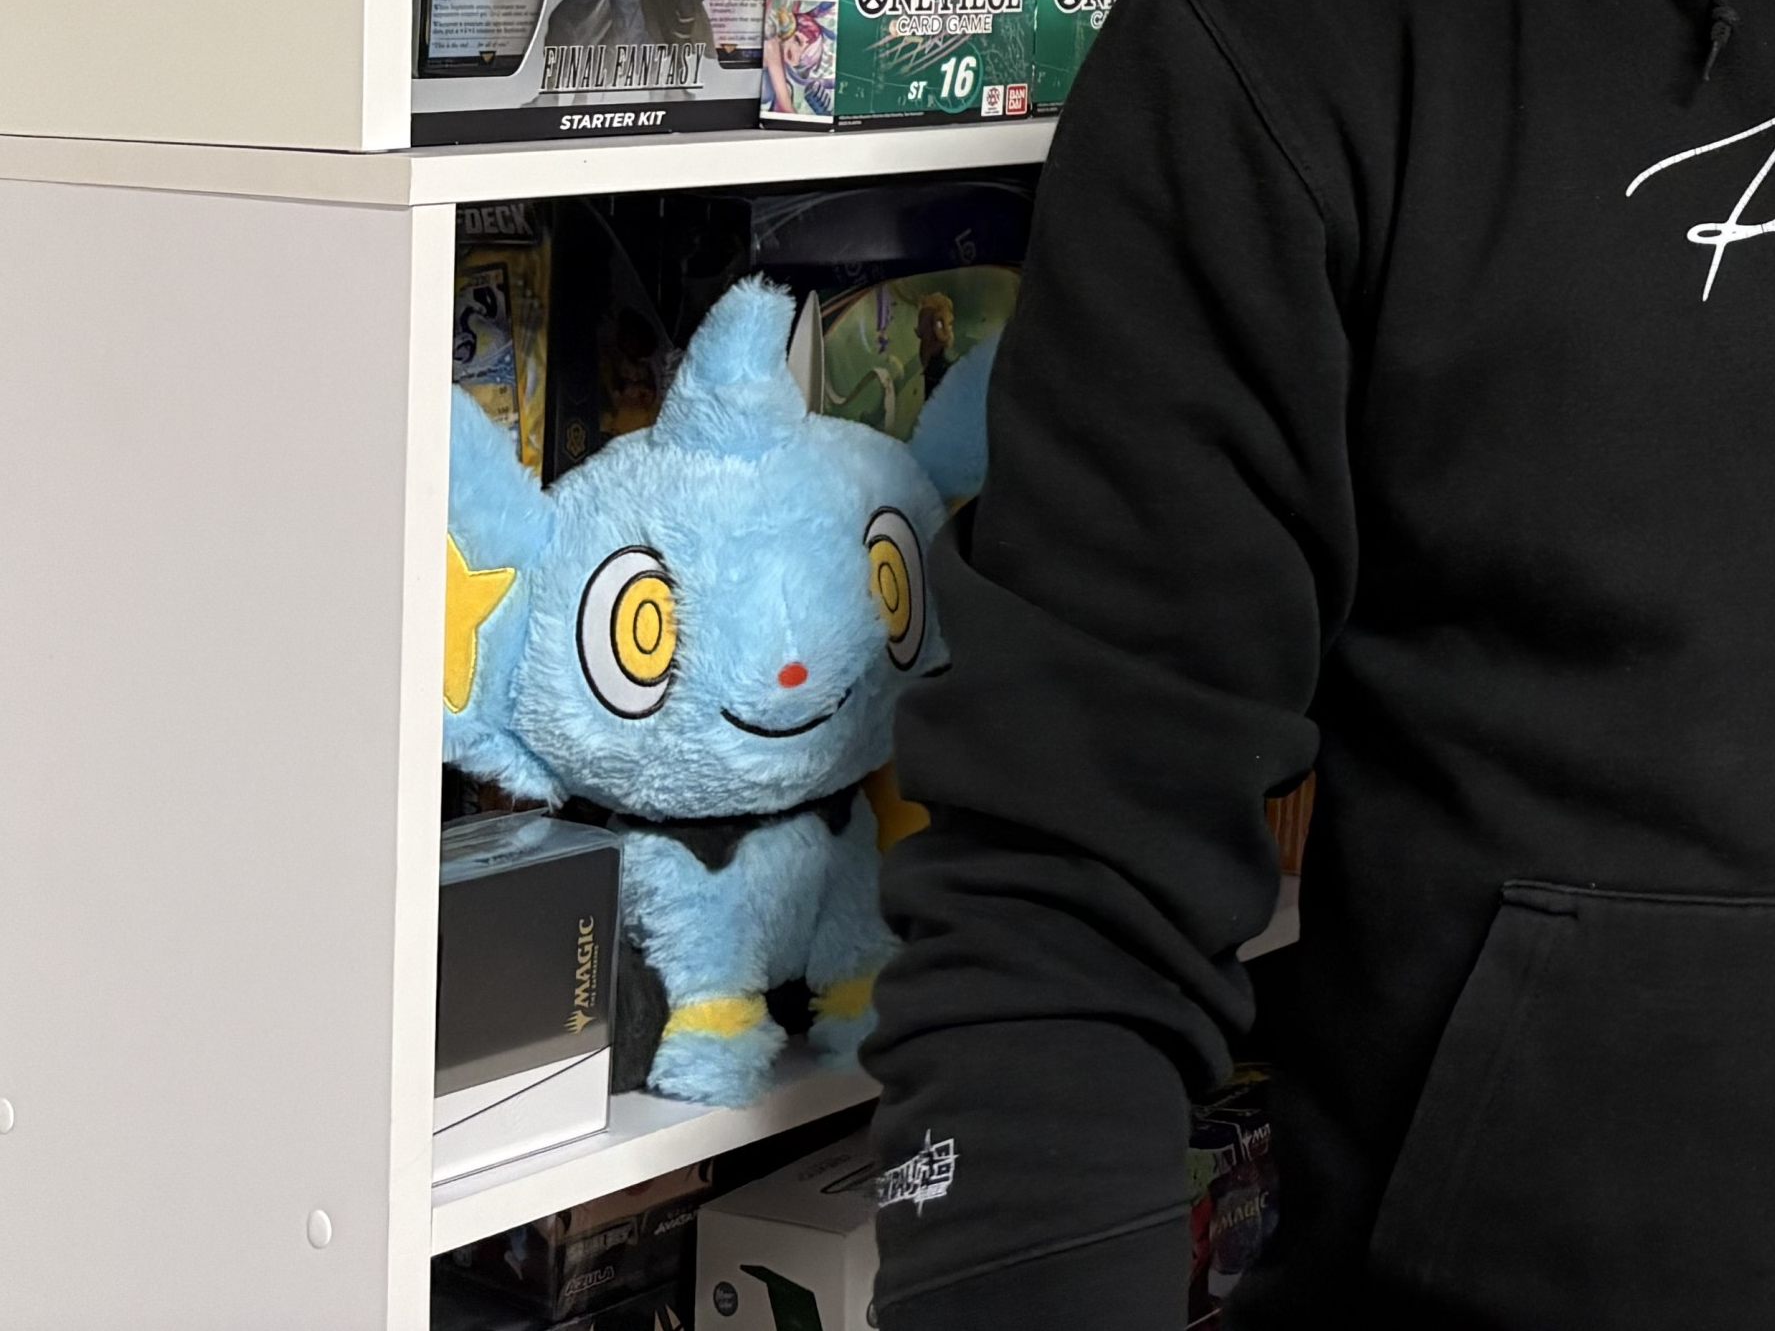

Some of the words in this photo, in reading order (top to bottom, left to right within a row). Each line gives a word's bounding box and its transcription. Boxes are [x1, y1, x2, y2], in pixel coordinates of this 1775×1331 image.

[897, 15, 942, 35] CARD
[947, 15, 993, 34] GAME
[540, 45, 606, 90] FINAL
[612, 42, 706, 89] FANTASY
[908, 81, 928, 100] ST
[940, 56, 977, 98] 16
[560, 113, 635, 131] STARTER
[637, 111, 666, 128] KIT
[465, 203, 534, 235] DECK
[574, 915, 595, 1008] MAGIC
